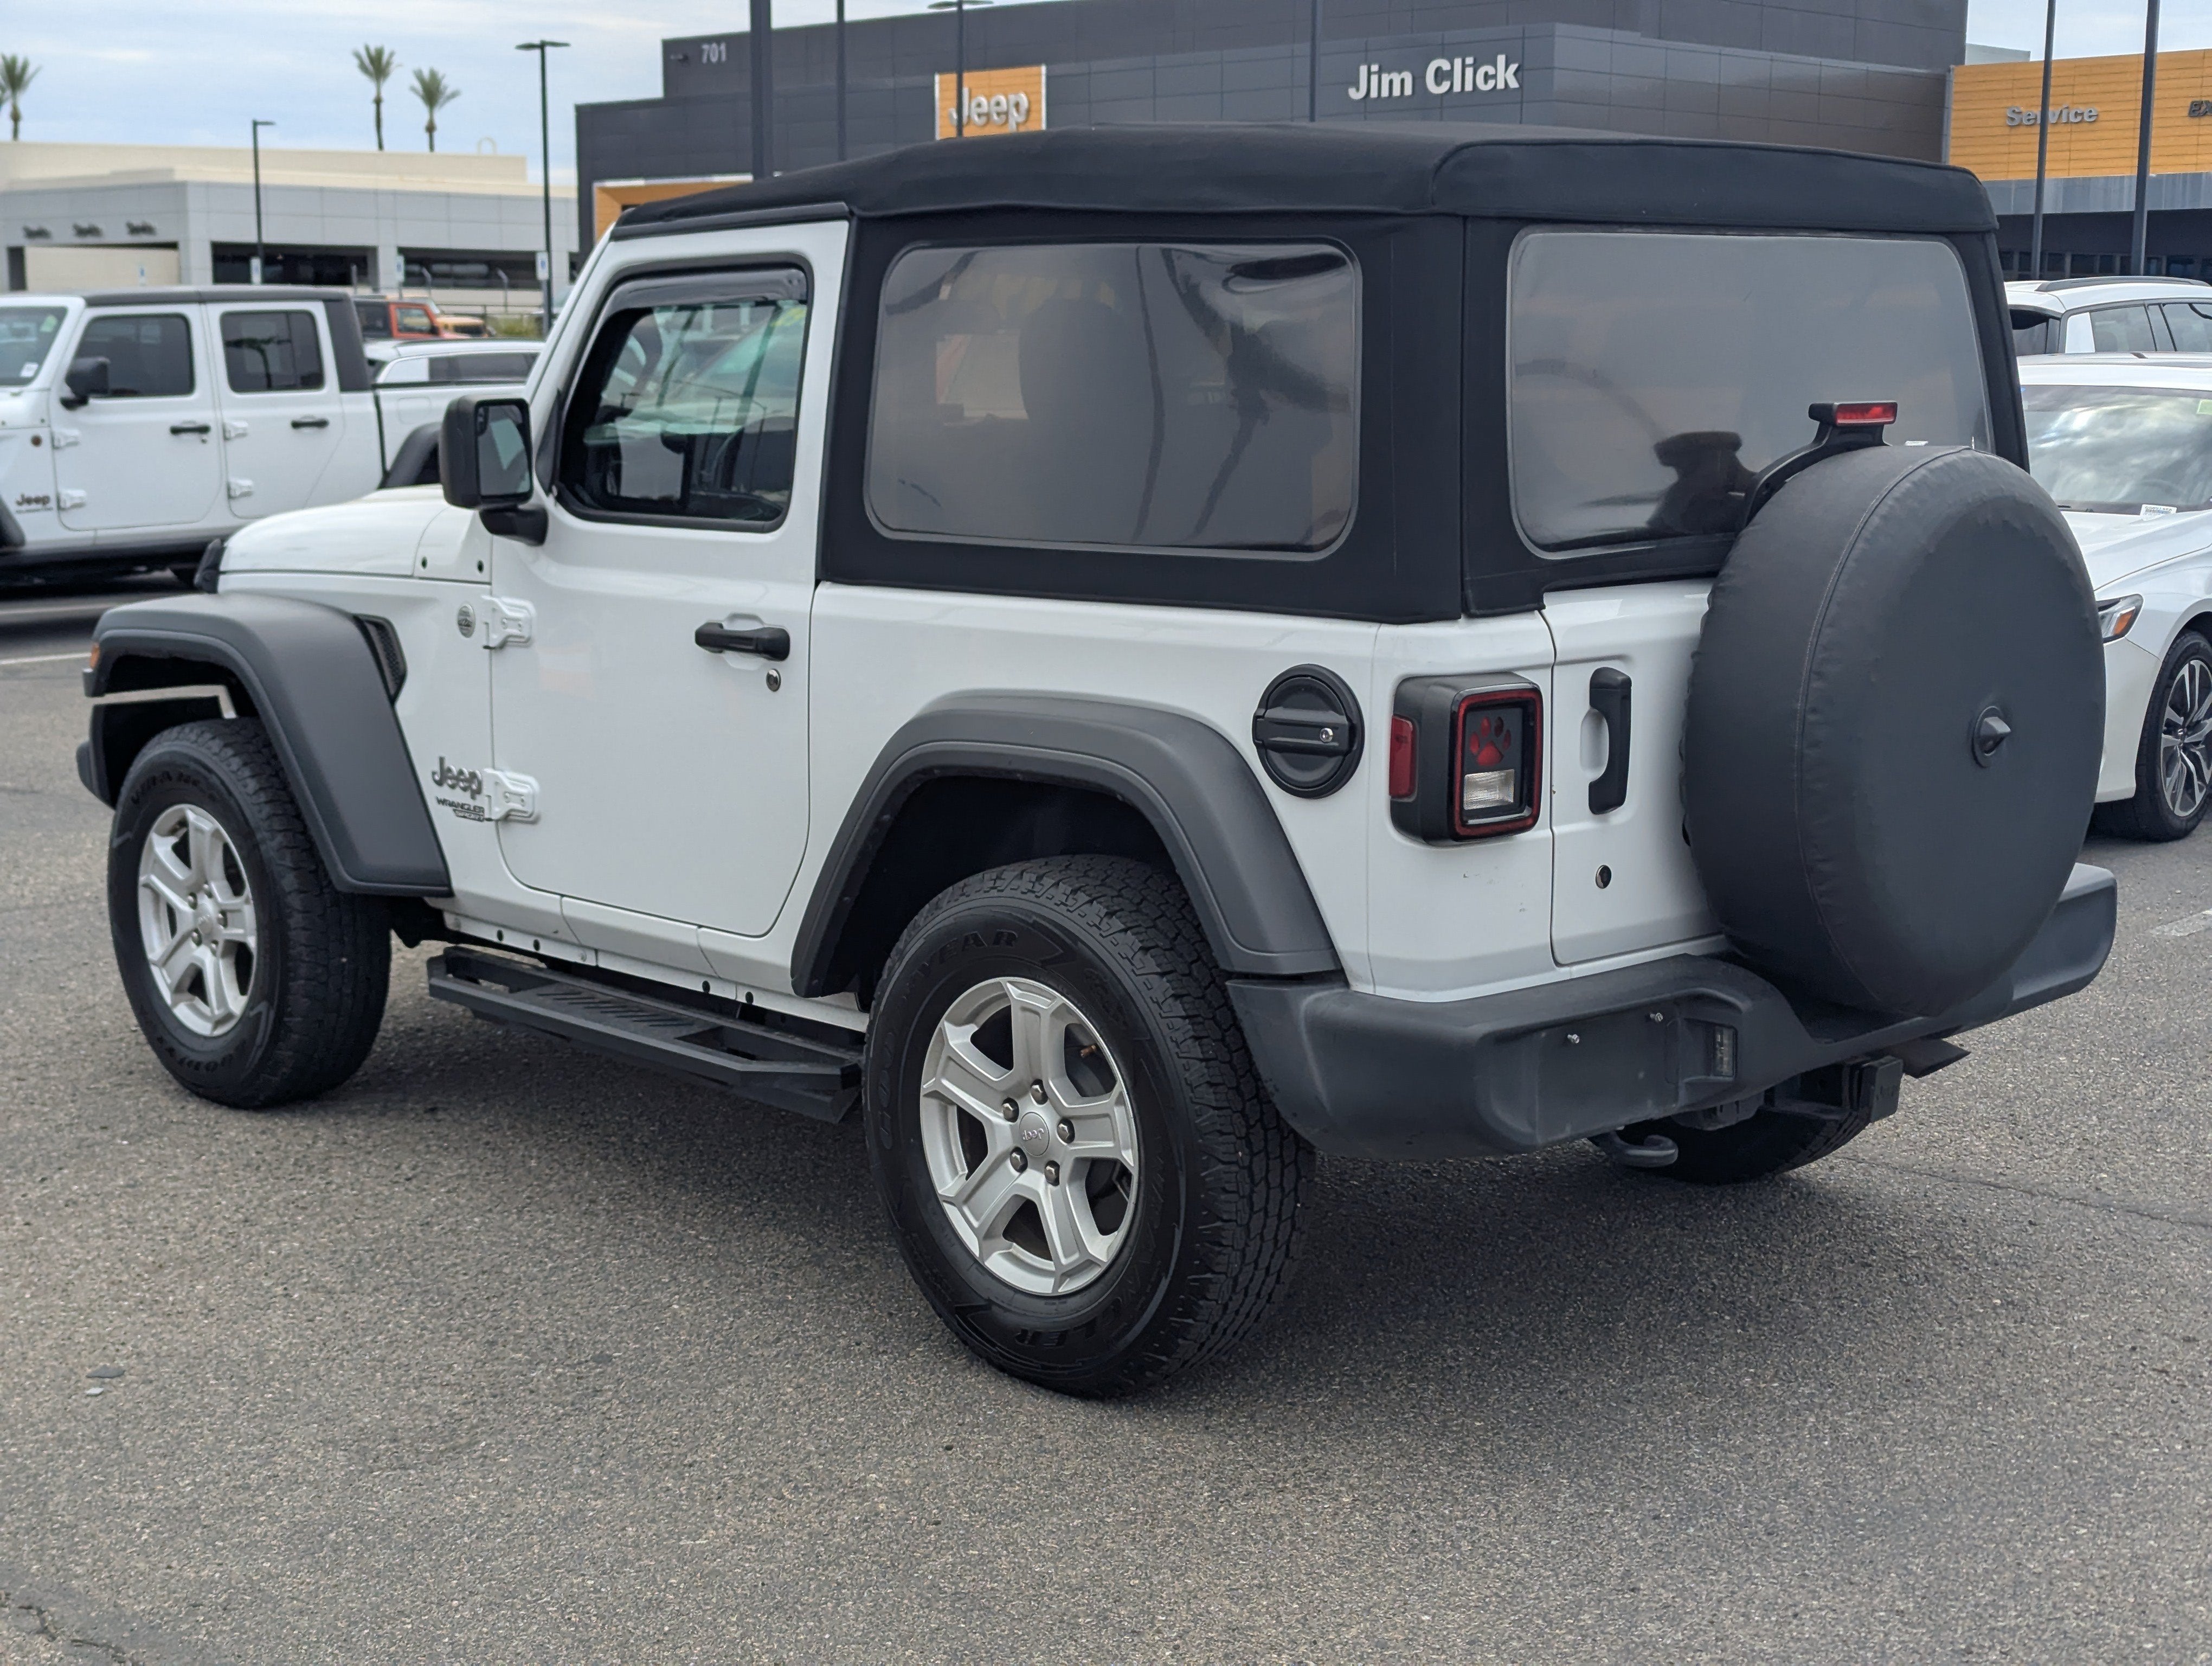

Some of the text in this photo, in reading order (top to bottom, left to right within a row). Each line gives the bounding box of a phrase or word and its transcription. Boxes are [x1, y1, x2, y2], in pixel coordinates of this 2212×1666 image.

[702, 42, 726, 63] 701
[1348, 54, 1520, 100] Jim Click
[948, 87, 1029, 132] Jeep
[431, 756, 482, 800] Jeep
[435, 796, 485, 814] WRANGLER
[1023, 1128, 1044, 1140] Jeep
